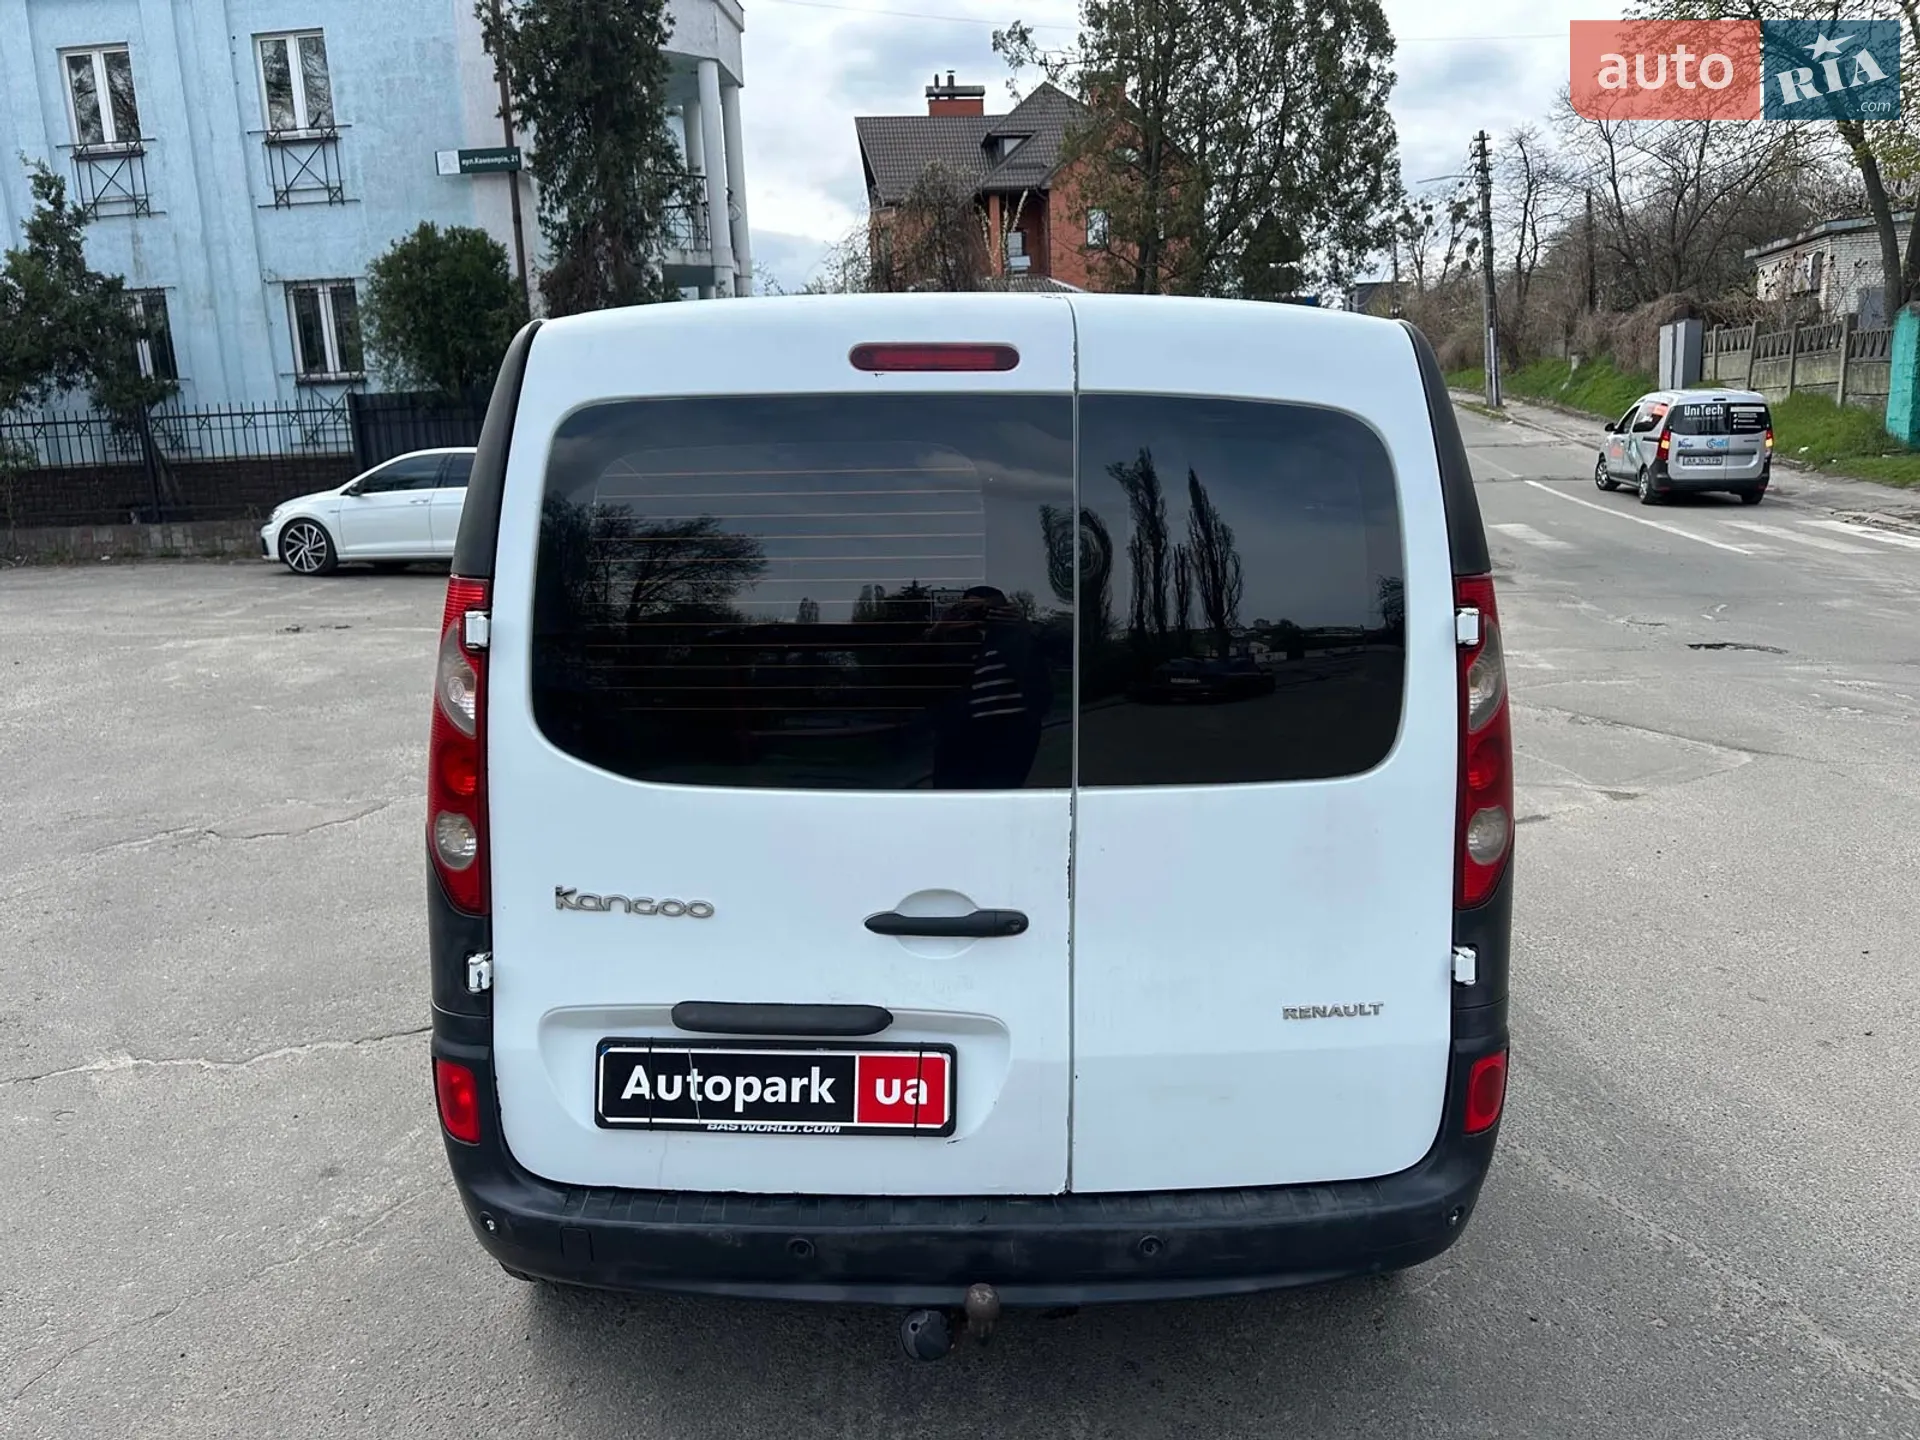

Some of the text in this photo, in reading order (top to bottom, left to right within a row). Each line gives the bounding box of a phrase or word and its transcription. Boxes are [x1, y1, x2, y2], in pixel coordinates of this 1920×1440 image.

[1684, 404, 1724, 417] UniTech
[555, 884, 715, 919] Kangoo
[1282, 1002, 1384, 1020] RENAULT
[621, 1064, 929, 1113] Autopark ua
